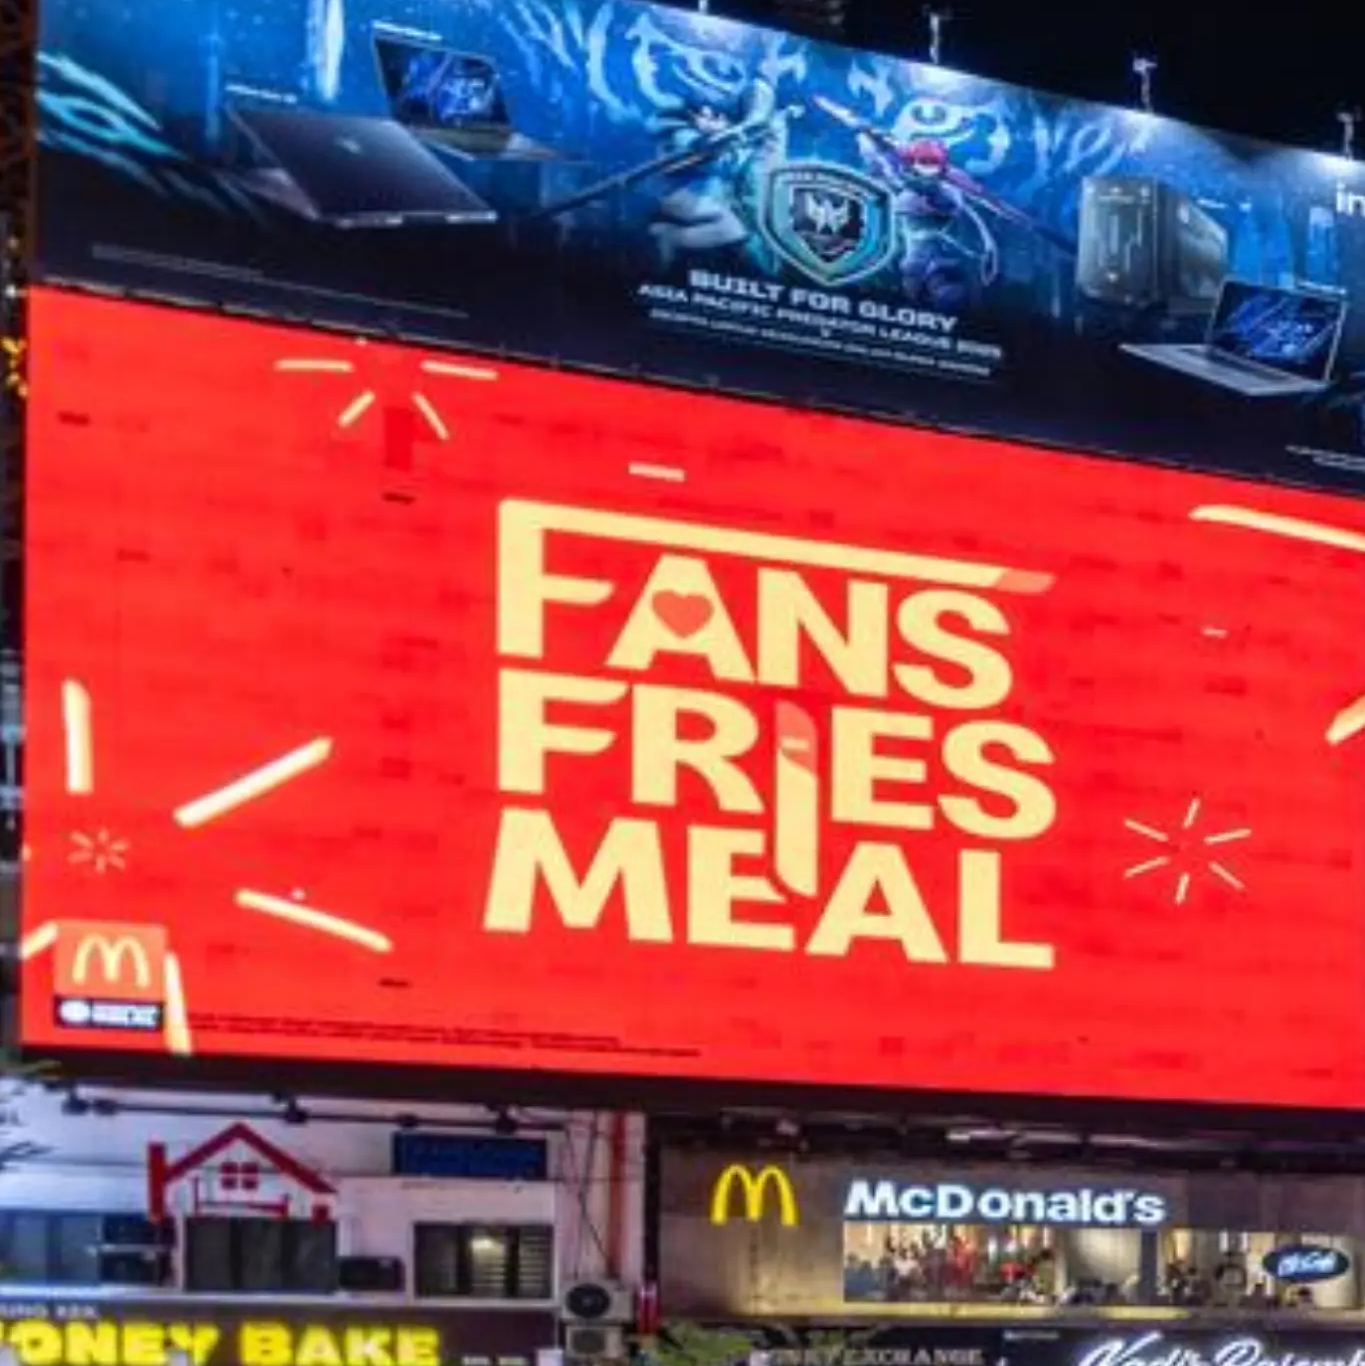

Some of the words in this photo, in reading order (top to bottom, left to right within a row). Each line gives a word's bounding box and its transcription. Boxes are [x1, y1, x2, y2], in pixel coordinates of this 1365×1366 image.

[688, 268, 785, 301] BUILT
[790, 288, 851, 315] FOR
[857, 300, 959, 333] GLORY
[497, 499, 1055, 709] FANS
[497, 668, 1057, 890] FRIES
[483, 807, 1056, 970] MEAL
[844, 1180, 1167, 1225] McDonald's
